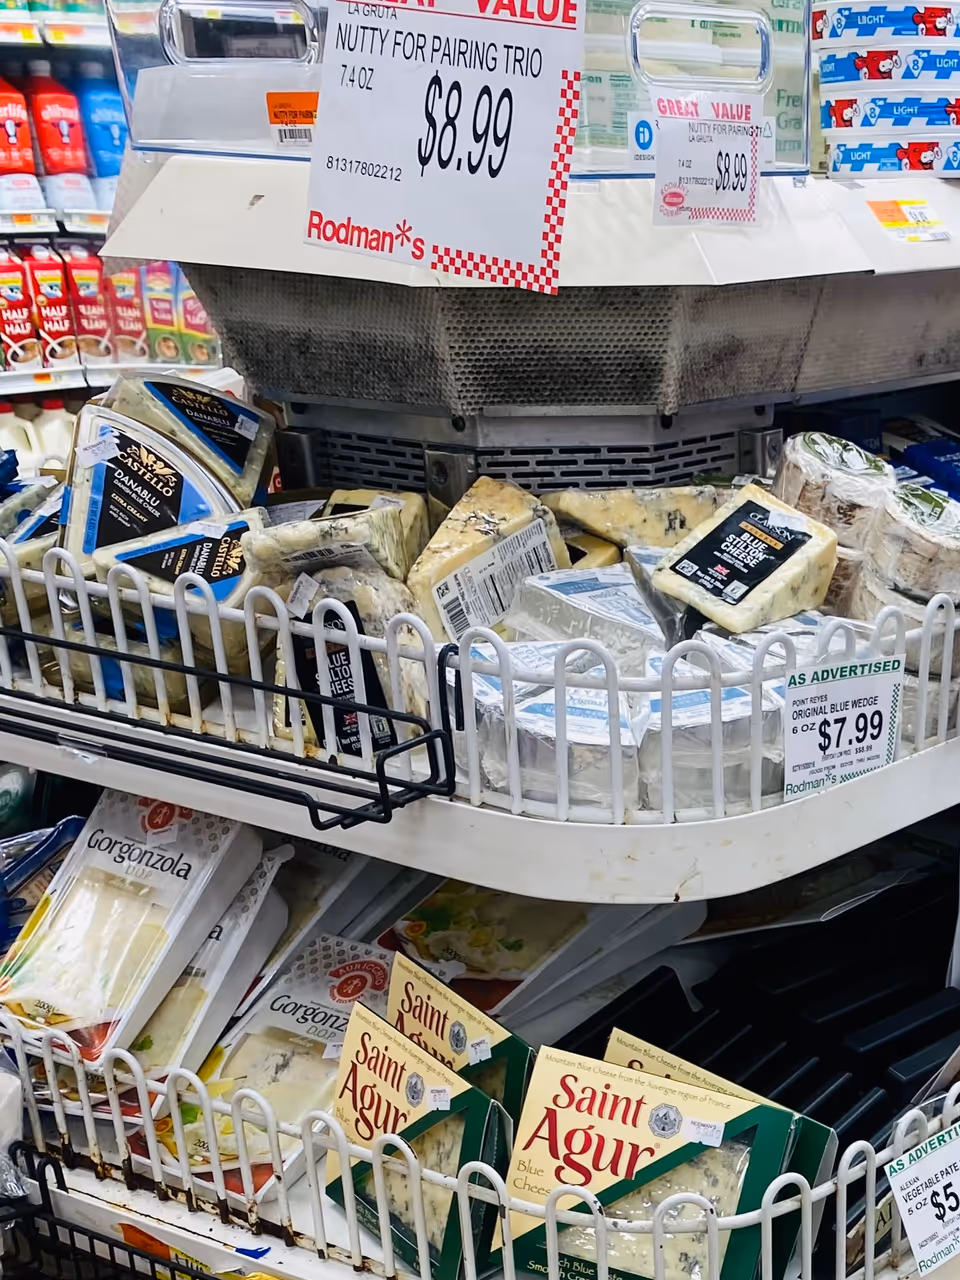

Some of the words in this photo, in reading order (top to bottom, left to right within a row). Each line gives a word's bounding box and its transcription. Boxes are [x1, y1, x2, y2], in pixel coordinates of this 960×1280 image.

[347, 5, 361, 16] LA
[363, 7, 397, 20] GRUTA
[335, 22, 391, 54] NUTTY
[392, 30, 427, 63] FOR
[430, 35, 497, 72] PAIRING
[503, 44, 543, 78] TRIO
[936, 59, 958, 68] LIGHT
[340, 65, 356, 87] 7.4
[358, 67, 374, 90] OZ
[711, 102, 752, 121] VALUE
[893, 106, 918, 115] LIGHT
[417, 70, 514, 178] $8.99
[688, 122, 711, 133] NUTTY
[713, 123, 727, 134] FOR
[851, 151, 871, 161] LIGHT
[326, 155, 402, 182] 81317802212
[715, 149, 748, 195] $8.99
[1, 308, 29, 321] HALF
[41, 306, 68, 318] HALF
[4, 322, 32, 335] HALF
[43, 319, 71, 332] HALF
[172, 396, 228, 417] CASTELLO
[186, 409, 230, 427] DANABLU
[118, 450, 174, 498] CASTELLO
[114, 469, 160, 507] DANABLU
[726, 534, 767, 562] STILTON
[740, 532, 768, 552] BLUE
[720, 541, 760, 568] CHEESE
[788, 673, 806, 688] AS
[811, 660, 901, 684] ADVERTISED
[792, 697, 809, 708] POINT
[810, 694, 828, 704] REYES
[792, 706, 829, 721] ORIGINAL
[830, 700, 850, 714] BLUE
[851, 696, 879, 710] WEDGE
[792, 726, 798, 735] 6
[801, 722, 817, 733] OZ
[818, 709, 884, 755] $7.99
[87, 828, 193, 882] Gorgonzola
[401, 982, 450, 1041] Saint
[356, 1032, 407, 1093] Saint
[339, 1060, 408, 1142] Agur
[552, 1074, 647, 1129] Saint
[522, 1106, 656, 1188] Agur
[516, 1159, 545, 1178] Blue
[889, 1159, 906, 1178] AS
[900, 1176, 920, 1192] ALEXIAN
[907, 1207, 914, 1216] 5
[915, 1197, 929, 1212] OZ
[572, 1262, 595, 1276] Blue
